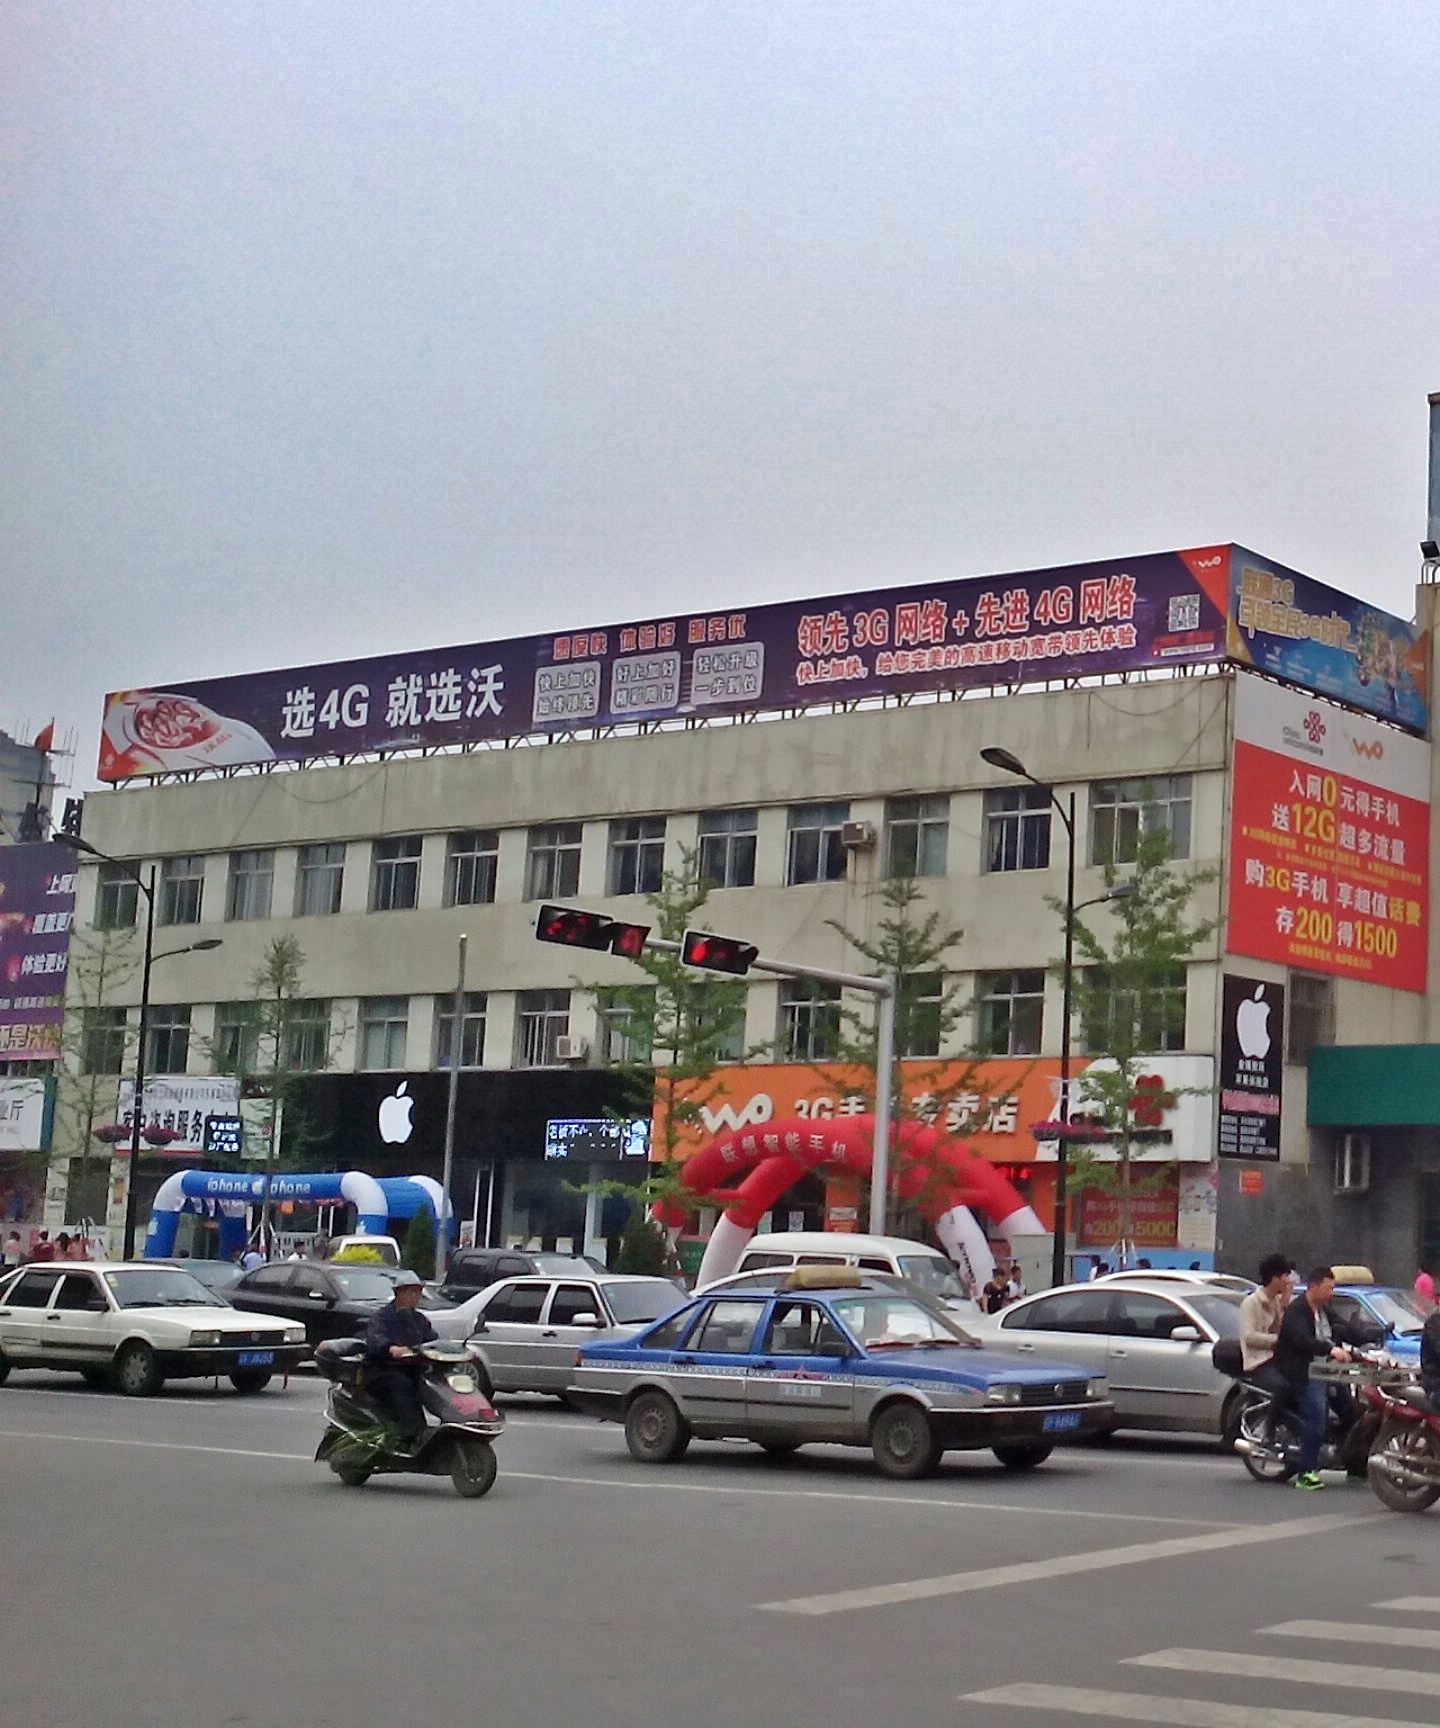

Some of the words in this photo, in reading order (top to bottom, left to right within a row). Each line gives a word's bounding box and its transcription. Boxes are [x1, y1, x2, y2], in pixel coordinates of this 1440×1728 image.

[688, 613, 748, 644] 服务优
[696, 650, 759, 675] 轻松升级
[385, 664, 505, 730] 就选沃
[794, 1092, 1018, 1135] 3G手专卖店
